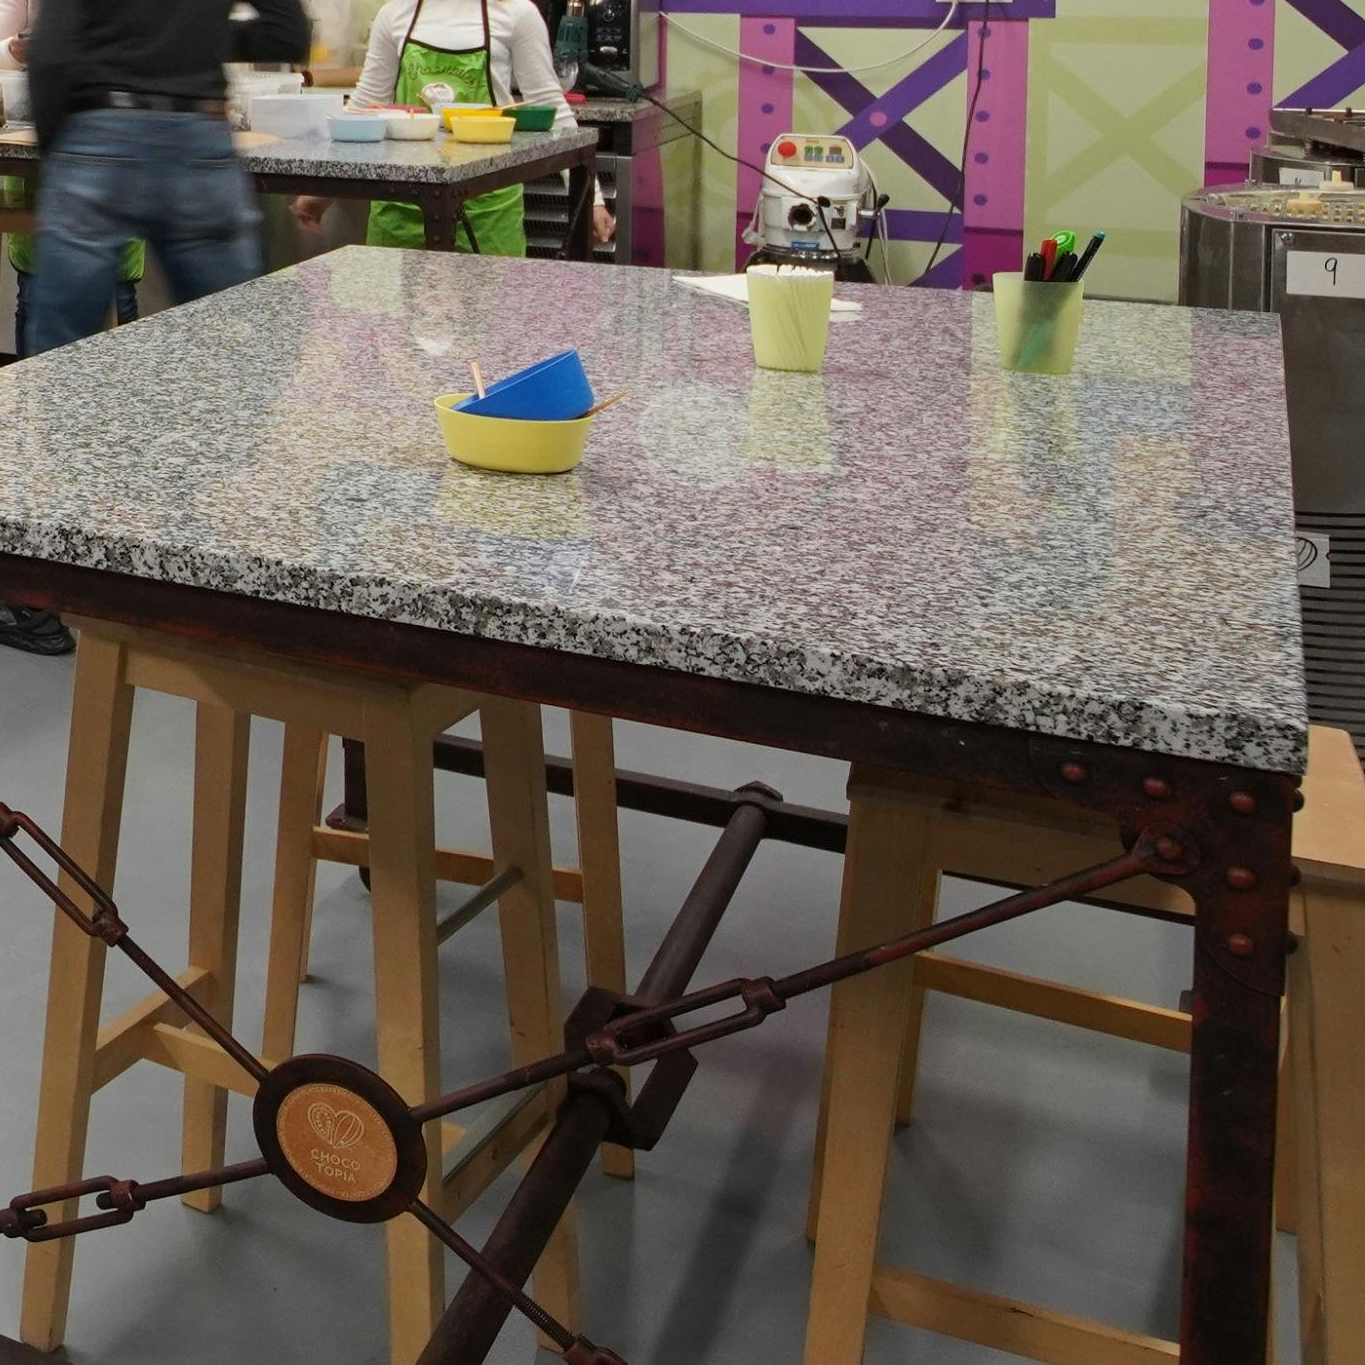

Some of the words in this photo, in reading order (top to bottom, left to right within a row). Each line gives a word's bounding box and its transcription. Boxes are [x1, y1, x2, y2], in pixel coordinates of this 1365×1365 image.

[1324, 257, 1338, 286] 9
[310, 1148, 361, 1171] CHOCO
[315, 1161, 357, 1184] TOPIA
